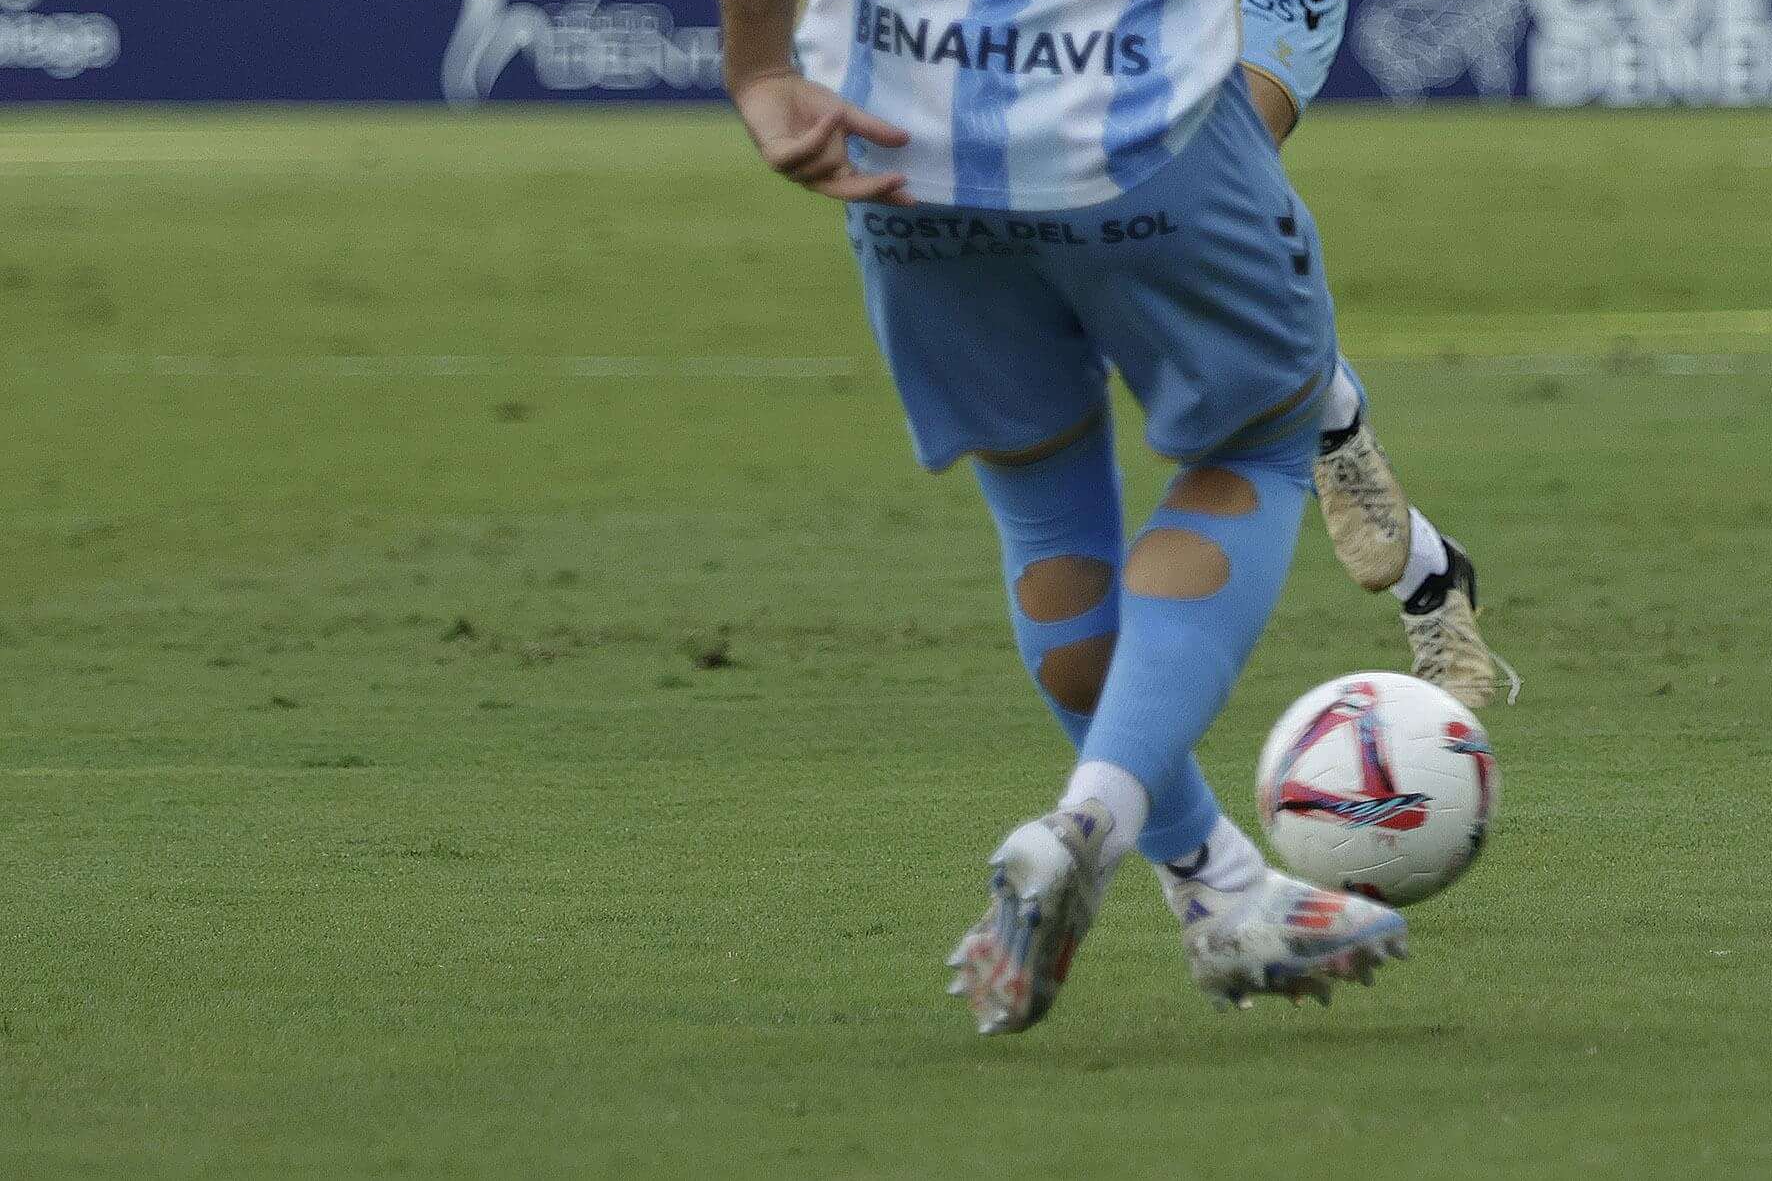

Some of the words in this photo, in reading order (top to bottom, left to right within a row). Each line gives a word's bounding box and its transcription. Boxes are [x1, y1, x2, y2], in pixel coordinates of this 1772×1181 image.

[865, 212, 994, 240] COSTA
[1007, 220, 1087, 246] DEL
[1101, 210, 1178, 245] SOL
